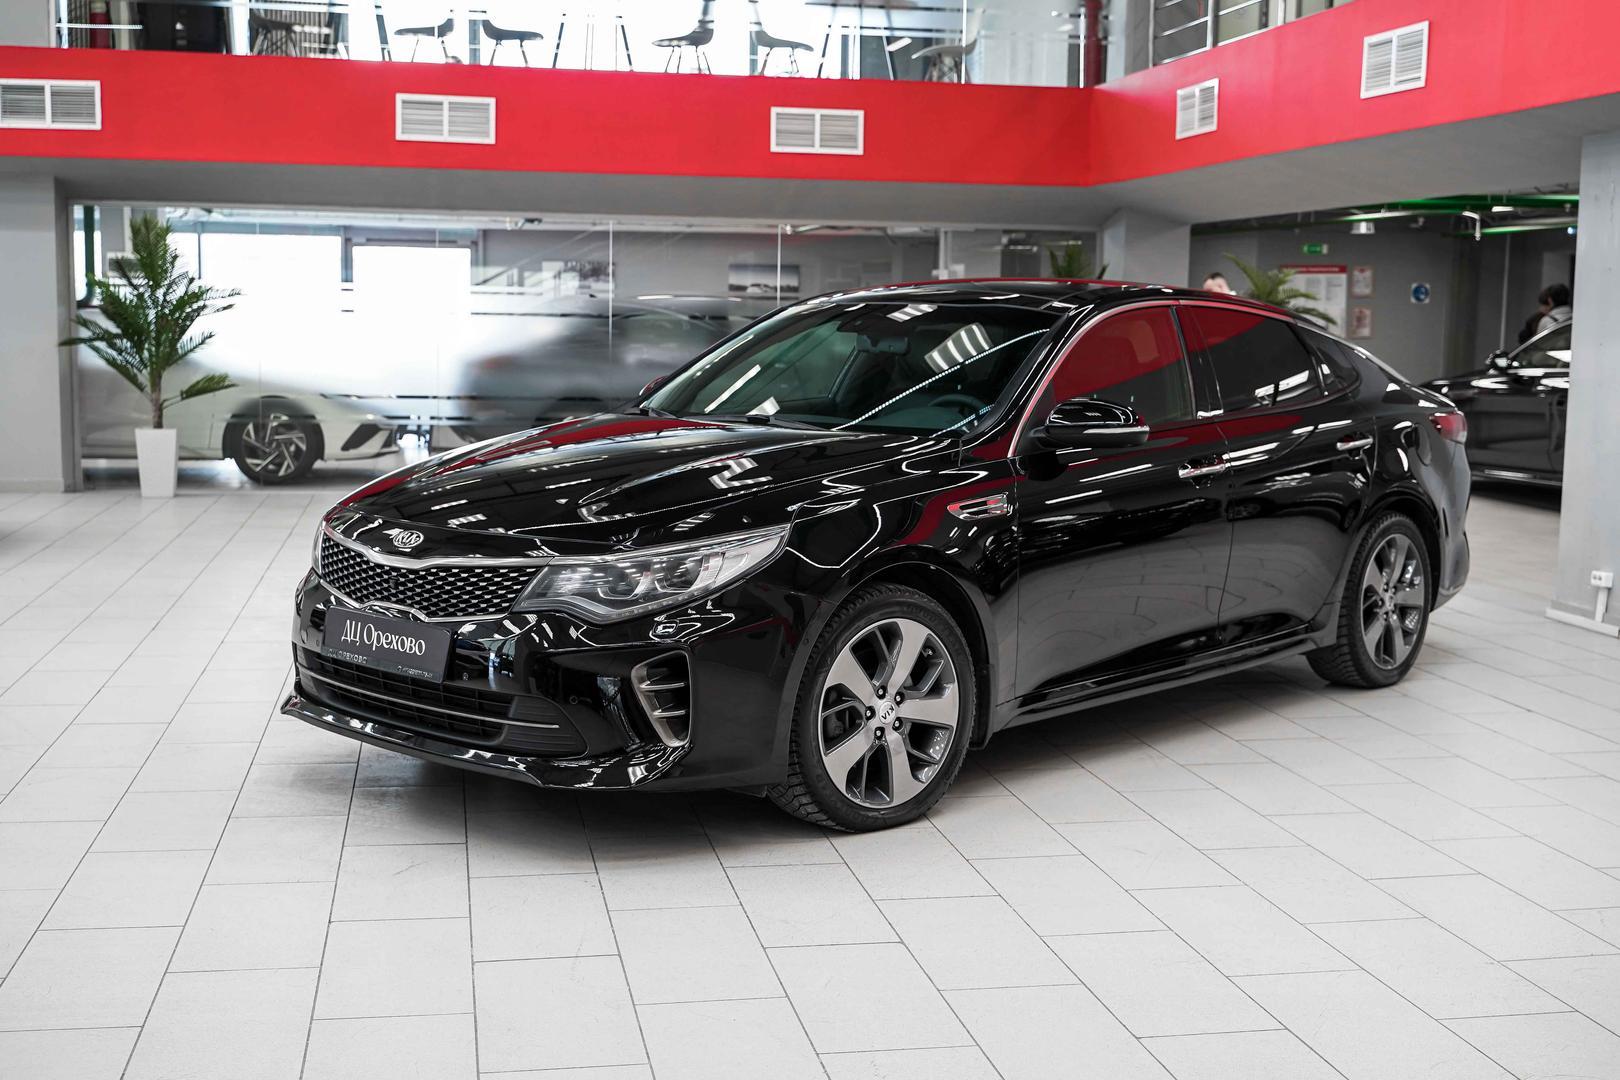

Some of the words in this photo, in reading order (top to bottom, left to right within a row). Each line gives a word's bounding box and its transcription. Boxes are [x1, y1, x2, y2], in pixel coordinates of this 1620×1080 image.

[393, 531, 424, 547] KIA
[341, 619, 361, 647] ДЦ
[363, 623, 426, 656] Орехово
[881, 704, 895, 720] KIA
